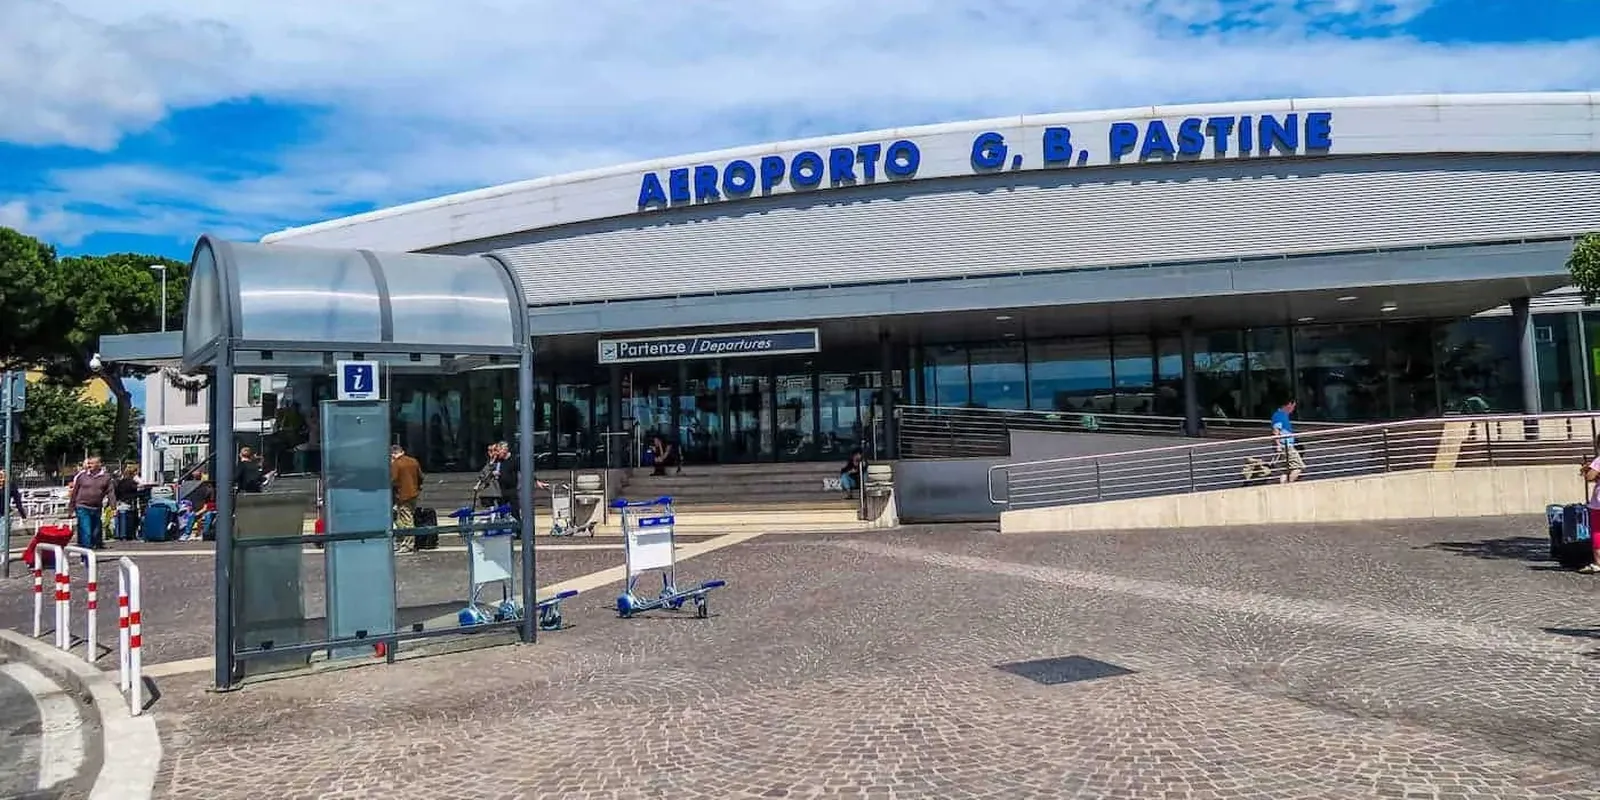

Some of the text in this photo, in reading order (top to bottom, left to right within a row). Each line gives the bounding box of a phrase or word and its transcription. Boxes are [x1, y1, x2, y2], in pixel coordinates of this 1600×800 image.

[638, 140, 921, 207] AEROPORTO
[1109, 112, 1333, 161] PASTINE
[619, 341, 687, 357] Partenze
[699, 339, 773, 354] Departures
